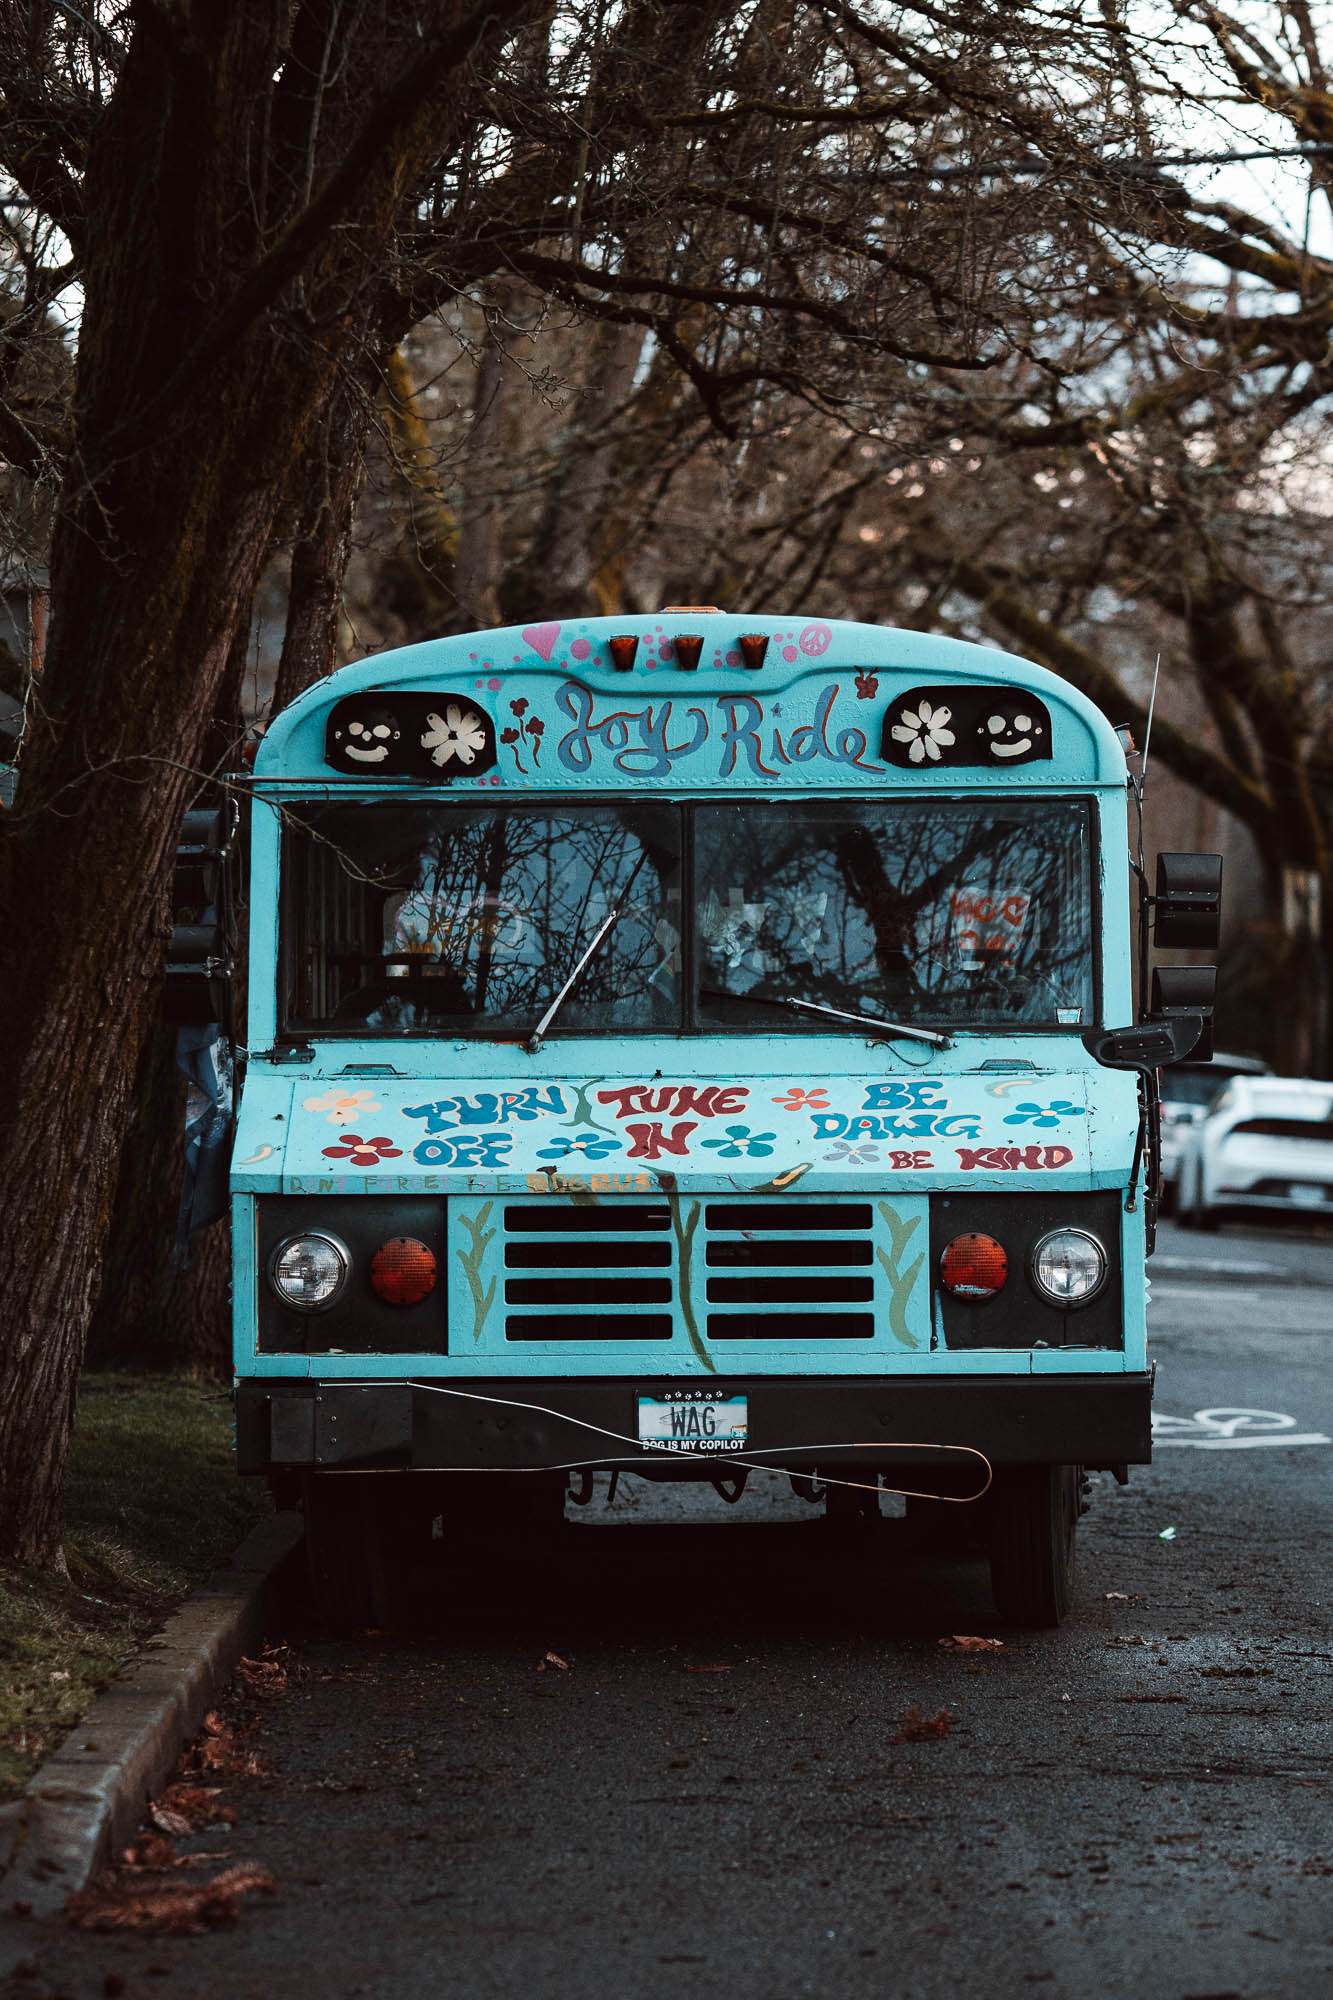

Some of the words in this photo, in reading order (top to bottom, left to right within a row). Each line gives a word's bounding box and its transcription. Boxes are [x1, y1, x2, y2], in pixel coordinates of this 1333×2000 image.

[717, 683, 887, 777] Ride
[401, 1085, 568, 1134] TURN
[596, 1084, 751, 1119] TUNE
[862, 1080, 950, 1111] BE
[624, 1121, 699, 1160] IN
[808, 1112, 983, 1141] DAWG
[408, 1132, 515, 1169] OFF
[887, 1149, 936, 1171] BE
[955, 1145, 1075, 1171] KIND
[364, 1175, 448, 1193] FORGET
[462, 1174, 511, 1192] THE
[671, 1406, 715, 1436] WAG
[642, 1440, 665, 1450] DOG
[668, 1440, 678, 1450] IS
[681, 1440, 697, 1450] MY
[699, 1440, 745, 1450] COPILOT
